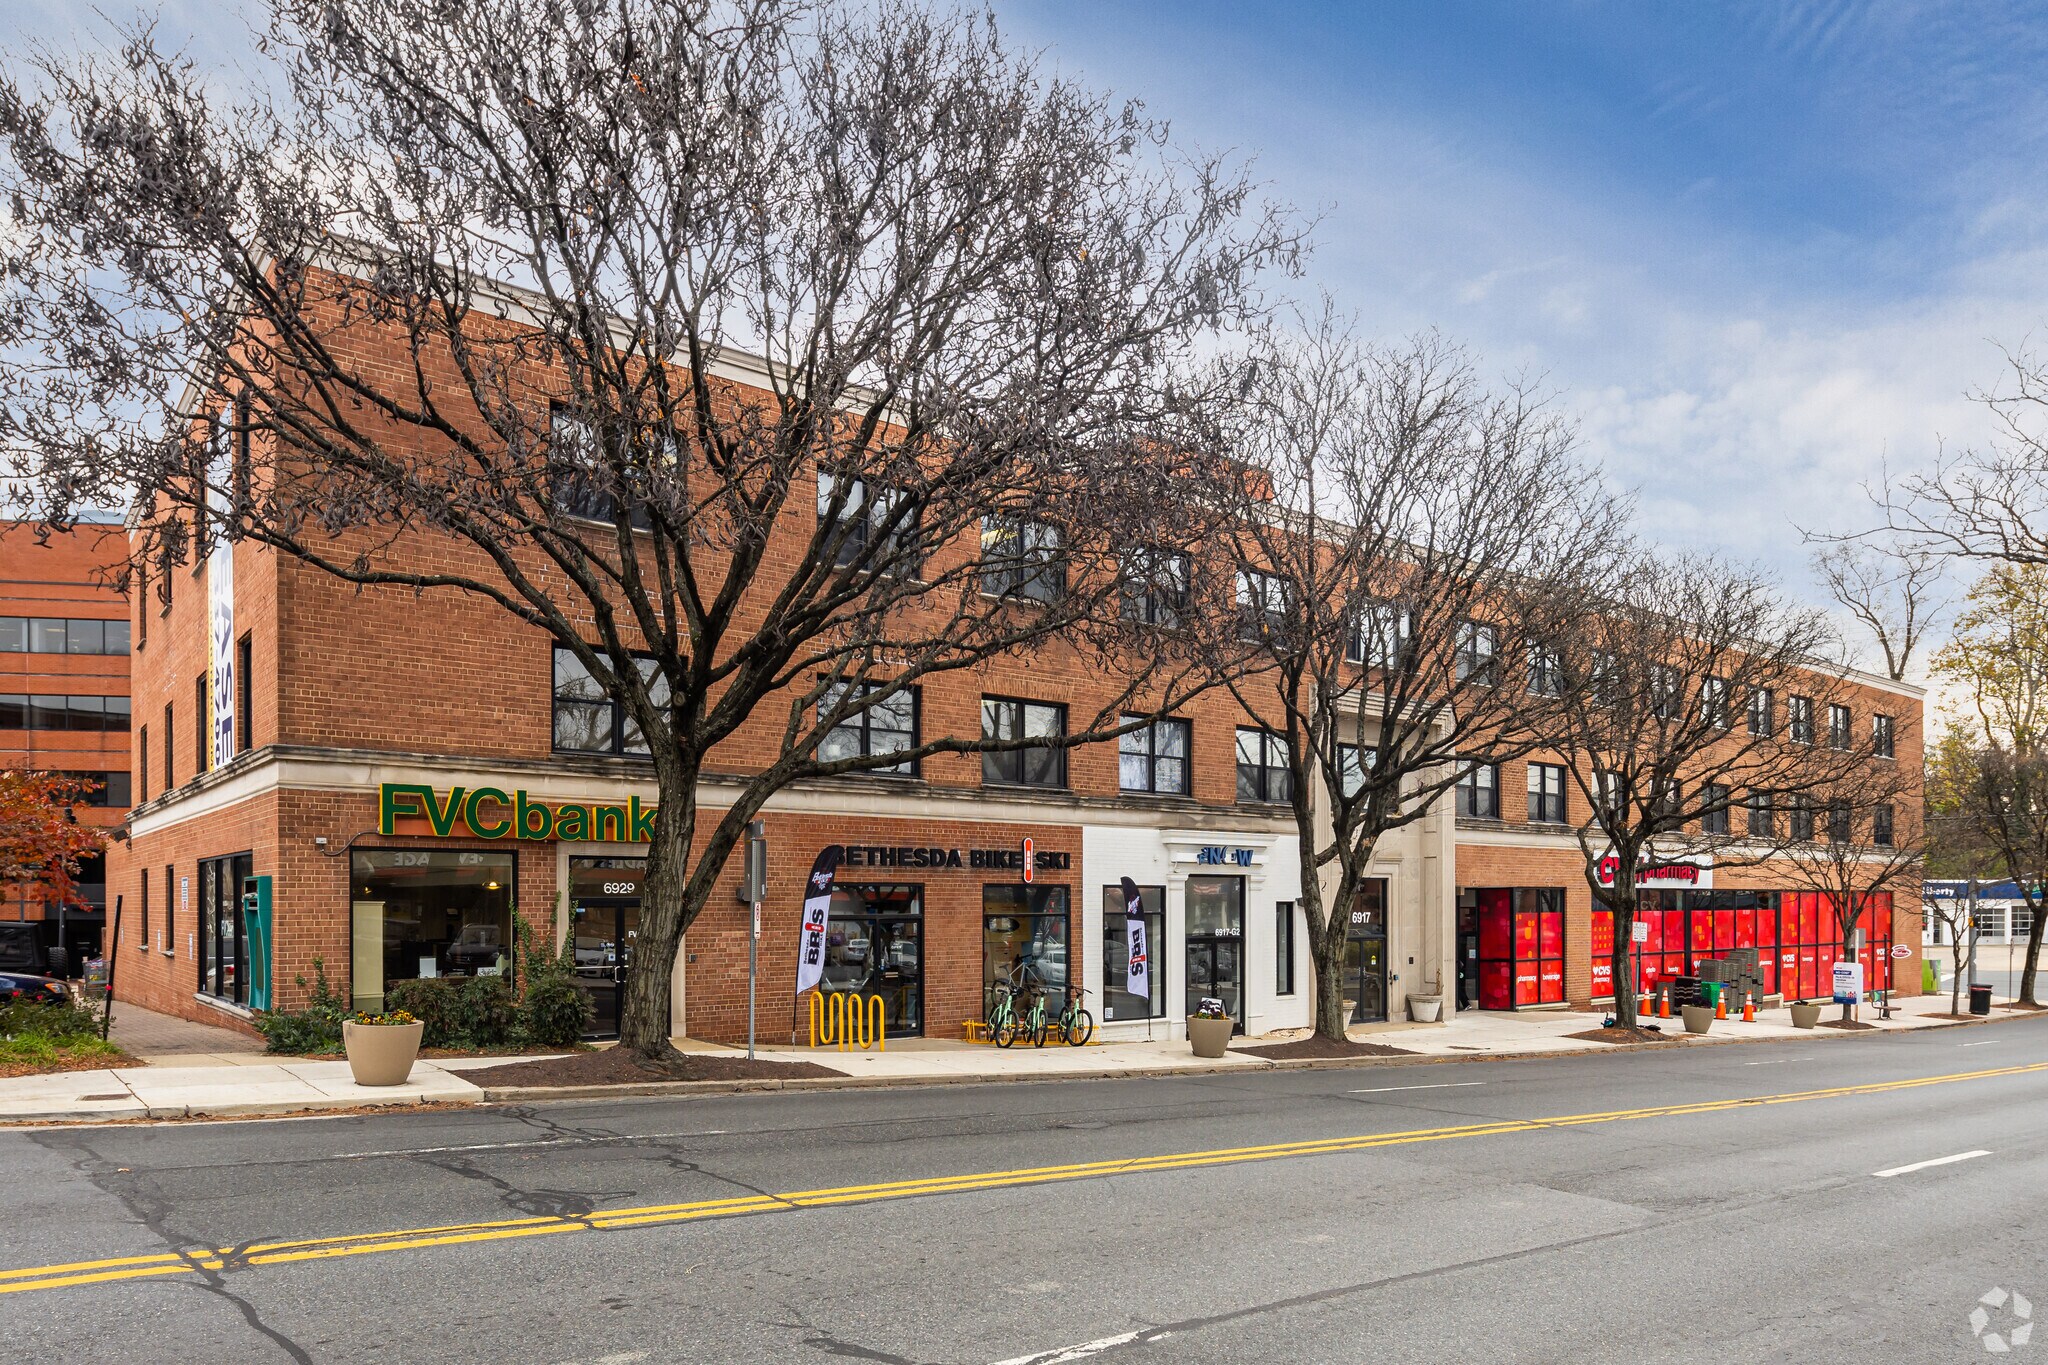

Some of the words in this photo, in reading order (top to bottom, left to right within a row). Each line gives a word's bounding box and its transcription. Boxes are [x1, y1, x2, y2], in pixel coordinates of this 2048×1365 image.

[221, 512, 233, 764] EASE
[379, 782, 658, 843] FVCbank
[970, 850, 1023, 869] BIKE
[1035, 851, 1071, 870] SKI
[603, 882, 635, 894] 6929
[1352, 911, 1371, 924] 6917
[1214, 927, 1241, 937] 6917-G2
[1599, 965, 1611, 975] CVS
[1517, 974, 1537, 984] pharmacy
[1542, 974, 1561, 982] beverage
[1593, 976, 1611, 984] pharmacy
